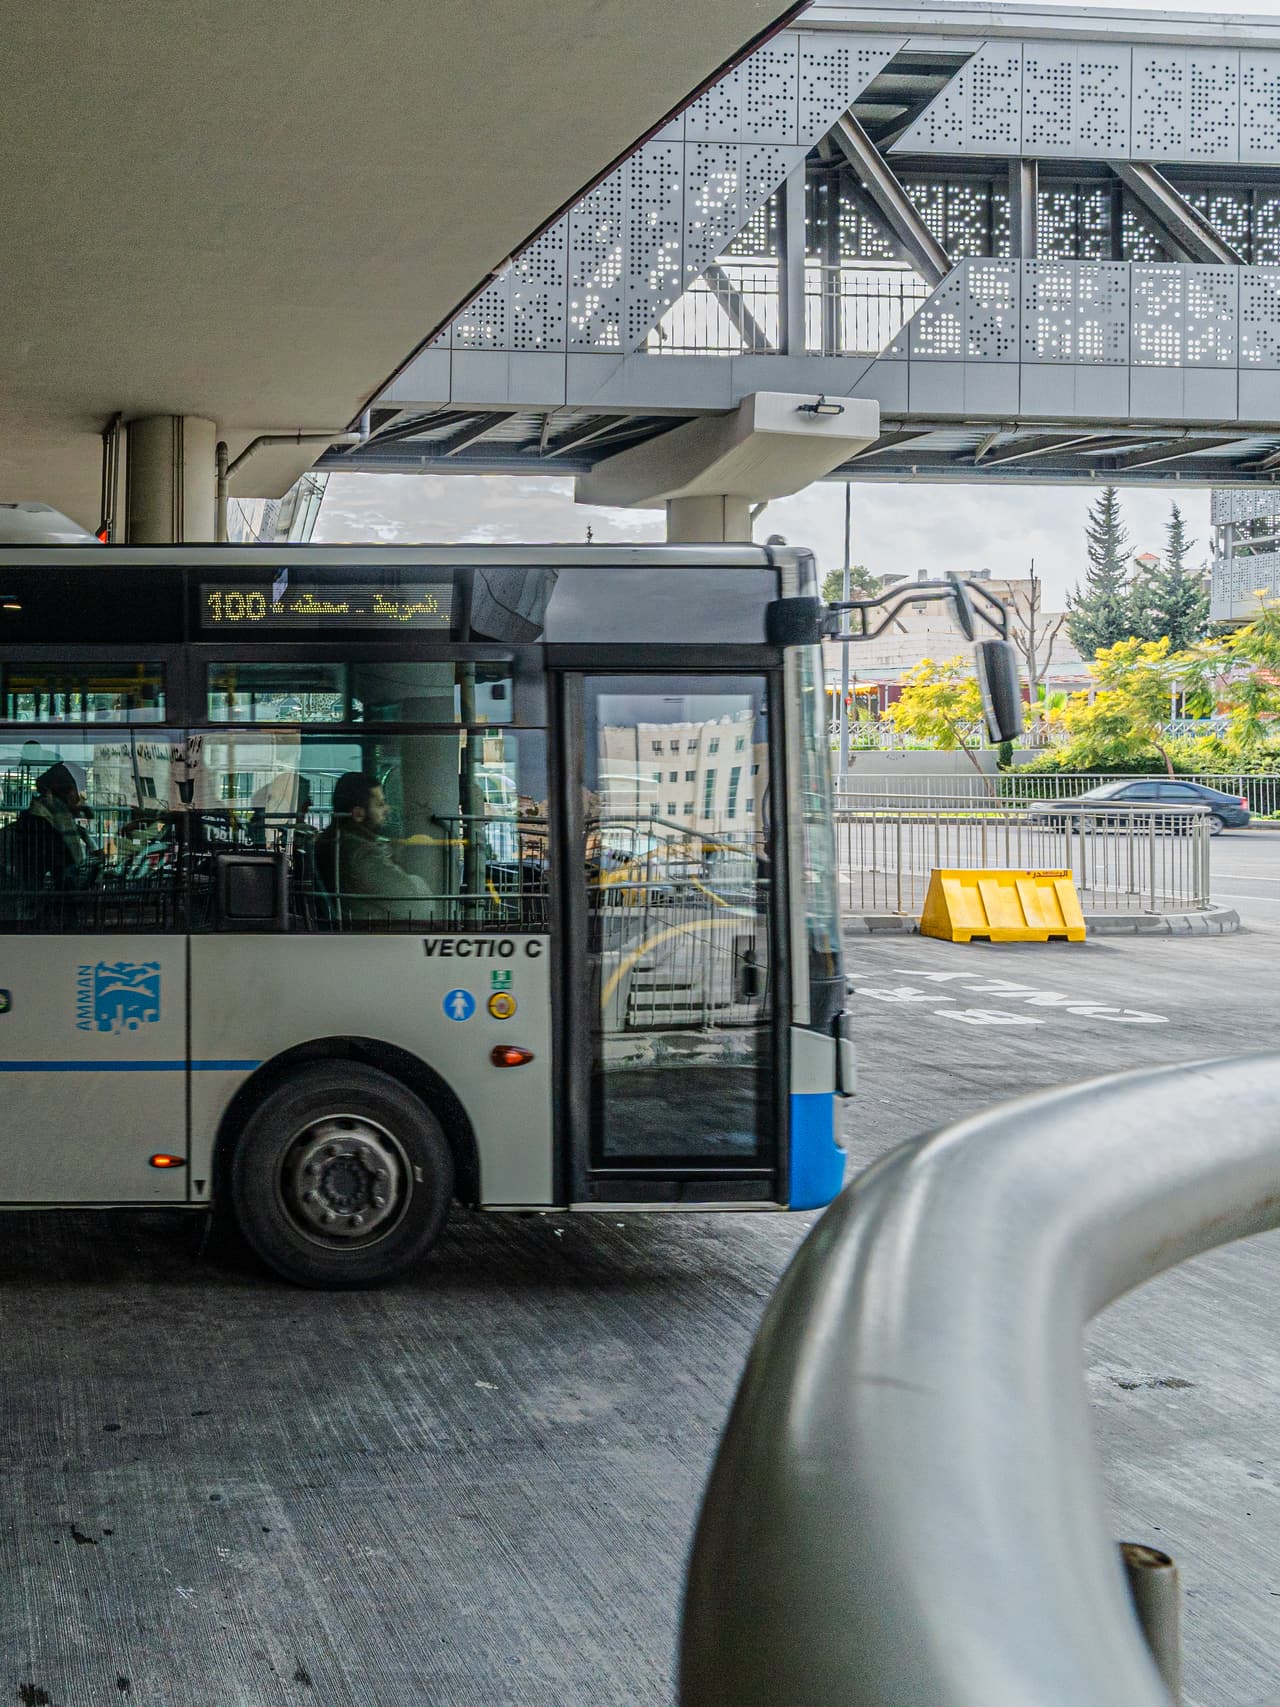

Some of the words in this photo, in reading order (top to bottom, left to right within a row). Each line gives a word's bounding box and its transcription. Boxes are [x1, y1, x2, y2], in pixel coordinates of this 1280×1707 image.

[207, 591, 266, 621] 100
[422, 938, 515, 958] VECTIO
[525, 939, 543, 958] C
[75, 964, 92, 1032] AMMAN
